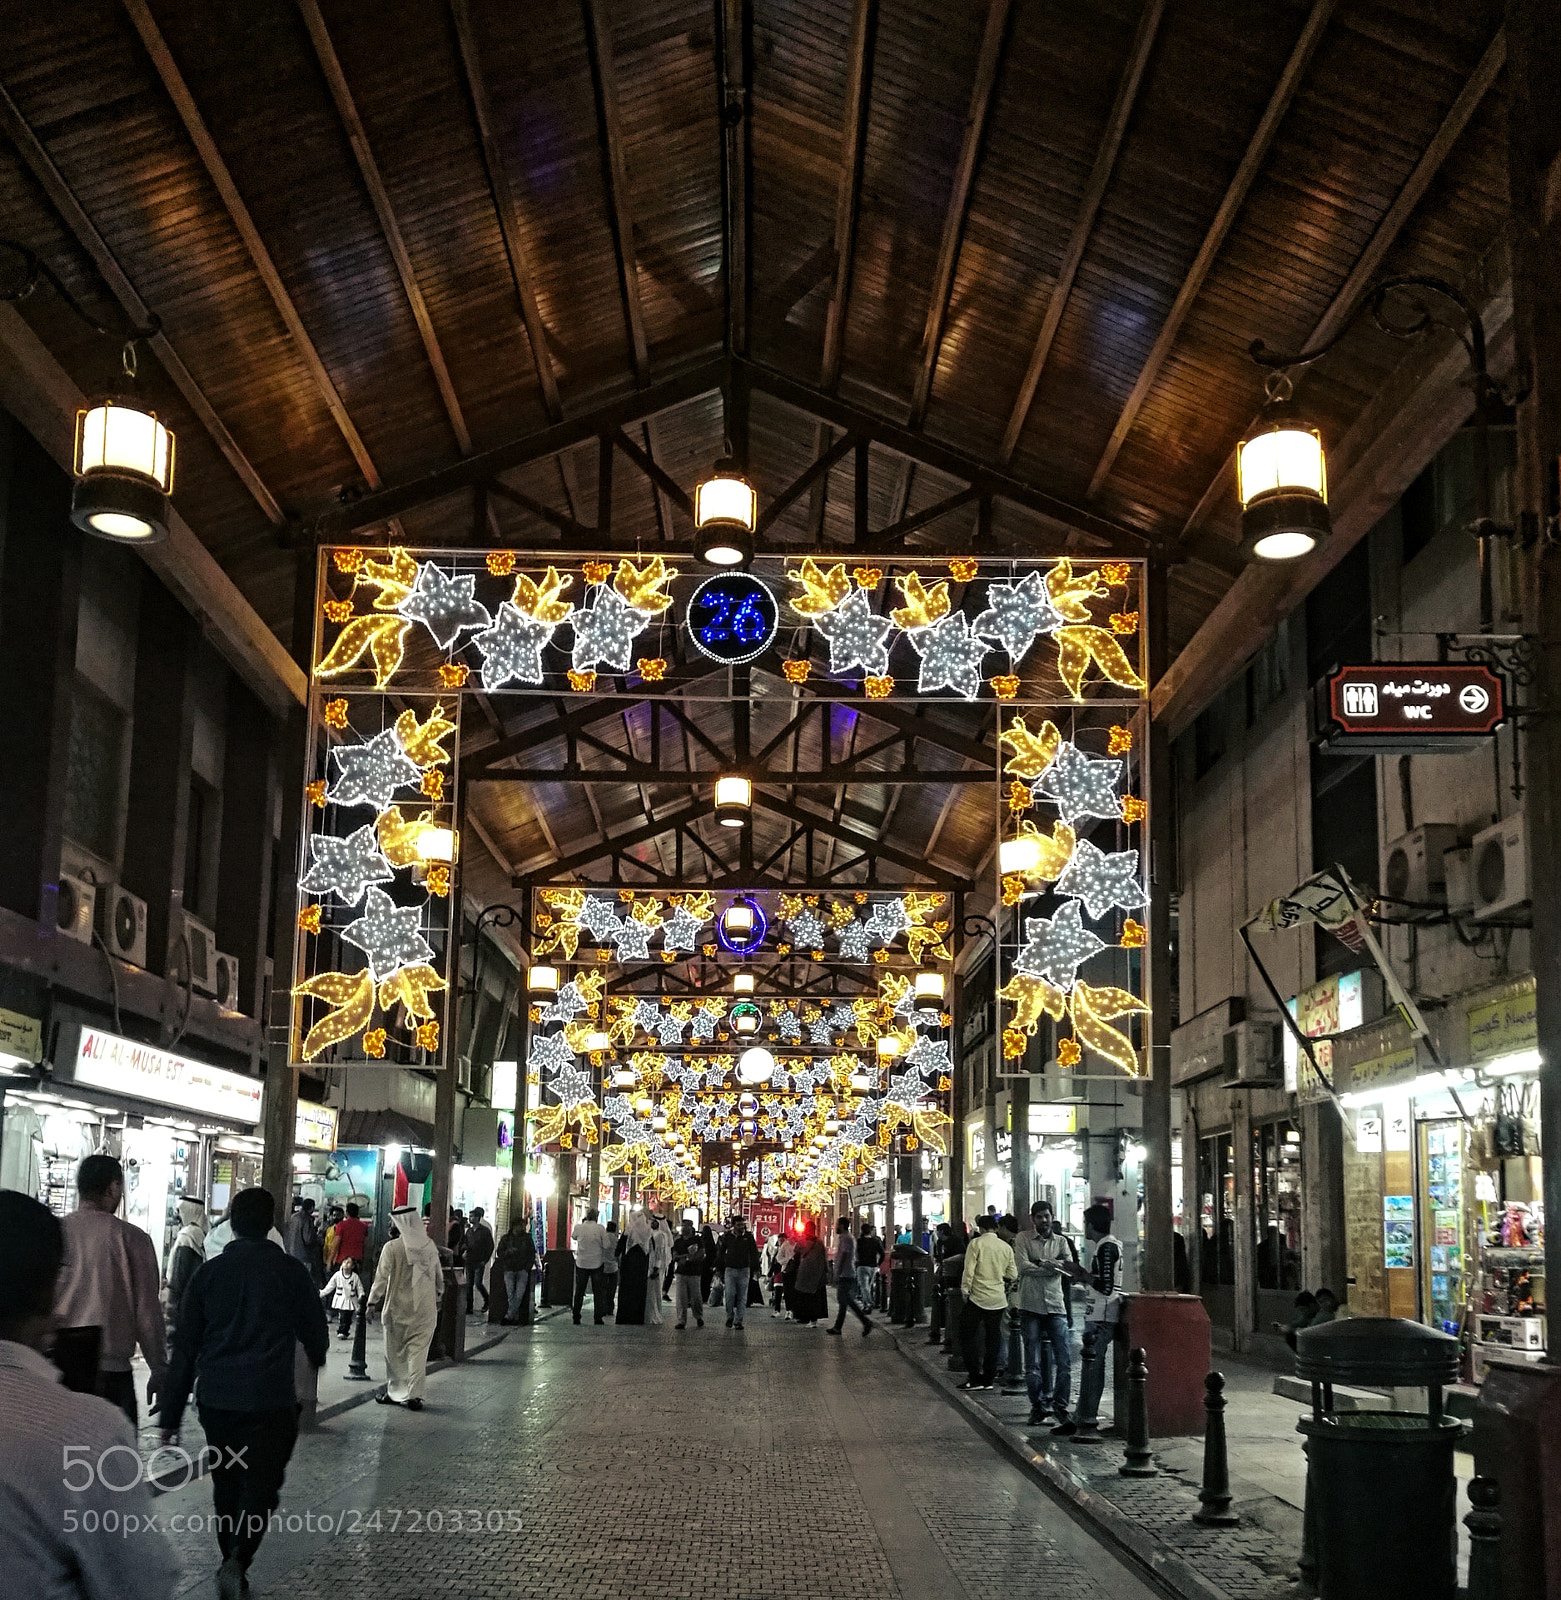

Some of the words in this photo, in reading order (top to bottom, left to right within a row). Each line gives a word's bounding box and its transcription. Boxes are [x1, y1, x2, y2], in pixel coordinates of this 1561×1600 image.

[701, 591, 766, 645] 26
[1383, 680, 1411, 698] مياه
[1412, 679, 1451, 698] دورات
[1403, 704, 1433, 720] WC
[82, 1033, 107, 1060] ALI
[110, 1042, 162, 1075] AL-MUSA
[165, 1058, 185, 1081] EST
[763, 1214, 778, 1222] 112
